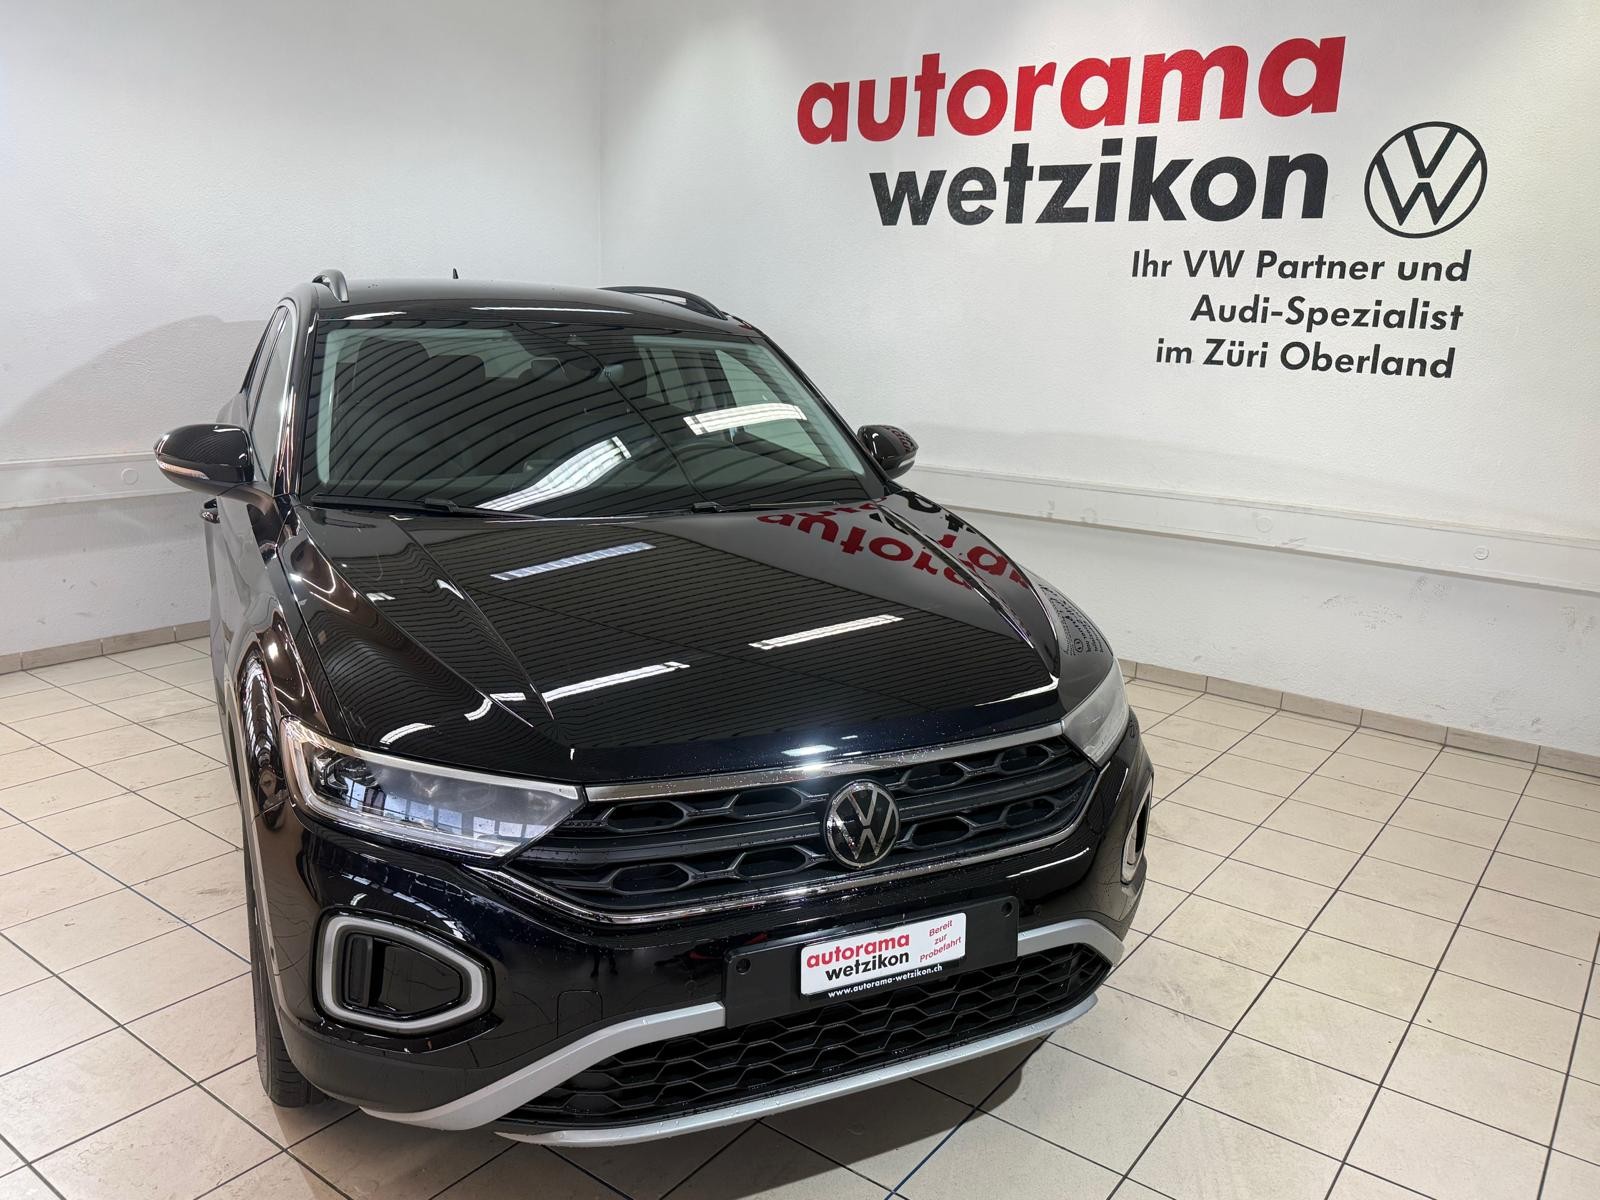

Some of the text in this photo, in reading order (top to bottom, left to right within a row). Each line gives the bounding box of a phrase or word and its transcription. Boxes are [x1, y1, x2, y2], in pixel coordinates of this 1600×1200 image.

[797, 37, 1346, 144] autorama
[869, 136, 1329, 226] wetzikon
[1131, 249, 1472, 282] Ihr VW Partner und
[1189, 293, 1465, 333] Audi-Spezialist
[1156, 337, 1456, 379] im Züri Oberland
[929, 919, 953, 937] Bereit
[934, 933, 948, 945] zur
[806, 933, 910, 969] autorama
[825, 951, 910, 981] wetzikon
[919, 936, 962, 963] Probefahrt
[828, 963, 943, 998] www.autorama-wetzikon.ch
